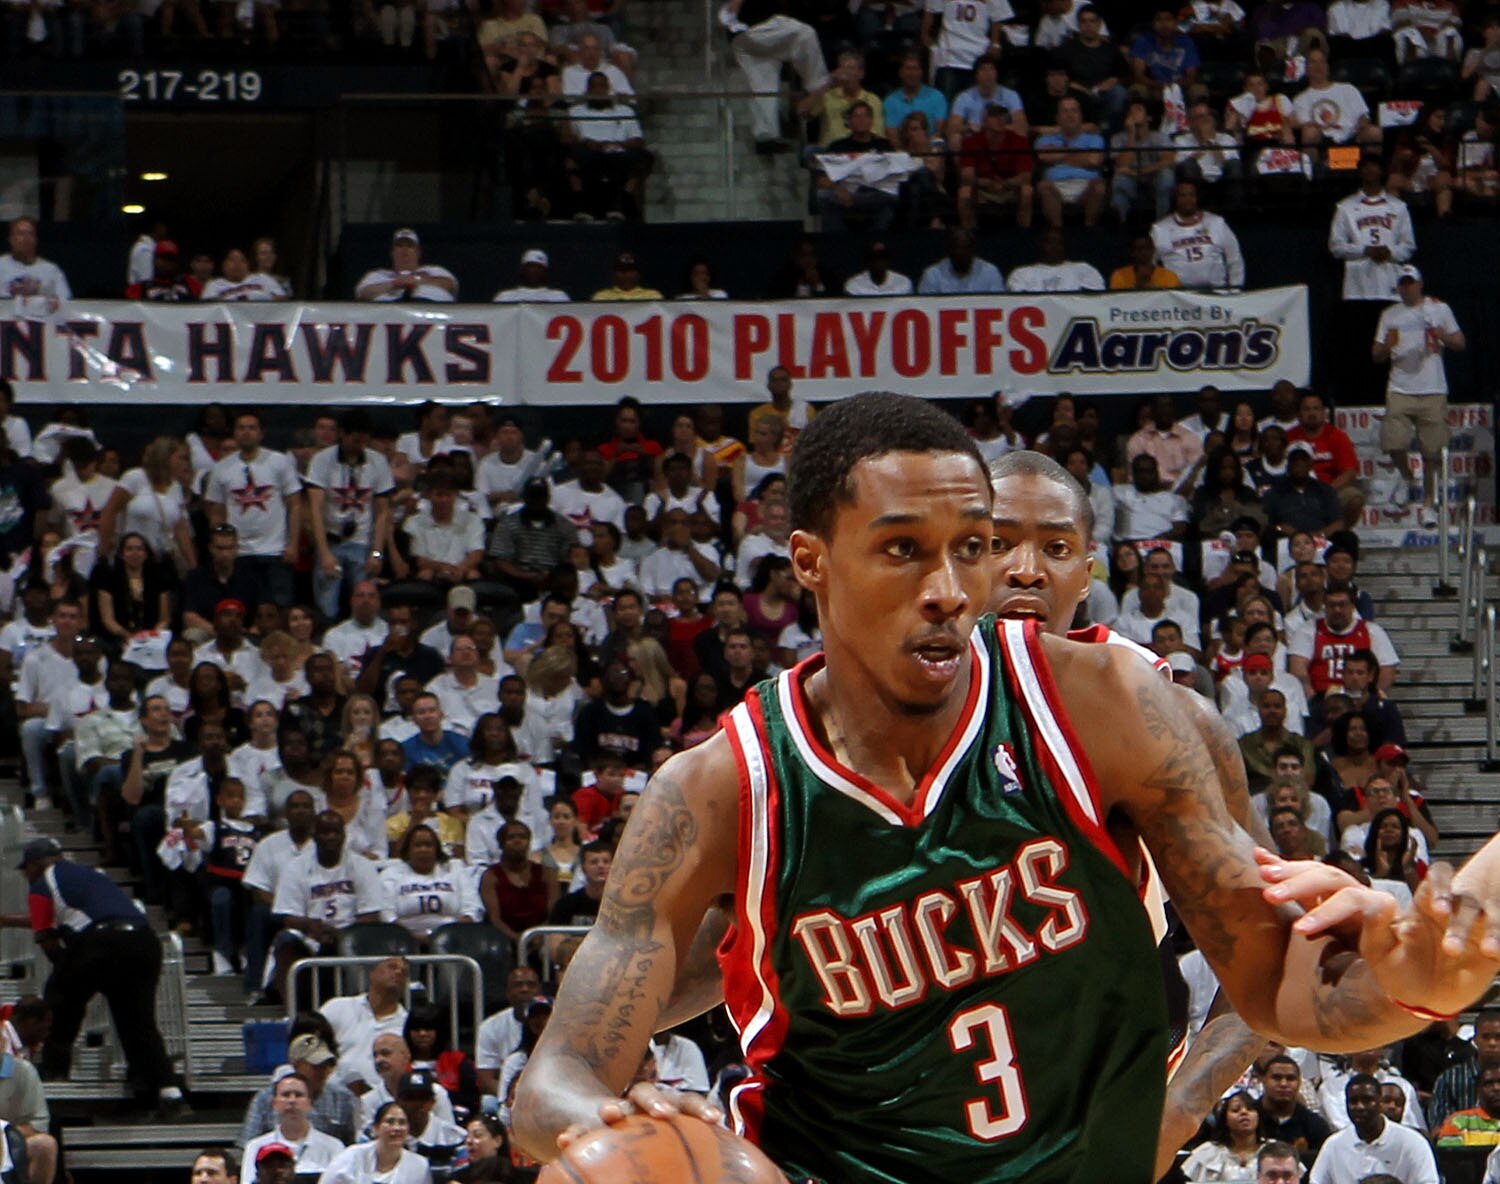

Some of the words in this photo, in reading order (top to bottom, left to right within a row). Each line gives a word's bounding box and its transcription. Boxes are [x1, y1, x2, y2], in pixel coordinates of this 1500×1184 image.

[117, 70, 262, 100] 217-219
[1370, 229, 1381, 245] 5
[1186, 247, 1203, 263] 15
[1109, 305, 1201, 322] Presented
[1211, 305, 1233, 323] By
[187, 323, 493, 385] HAWKS
[546, 313, 710, 383] 2010
[733, 305, 1049, 380] PLAYOFFS
[1050, 317, 1280, 374] Aaron's
[325, 900, 337, 917] 5
[419, 895, 442, 914] 10
[792, 840, 1089, 1018] BUCKS
[948, 1001, 1029, 1143] 3
